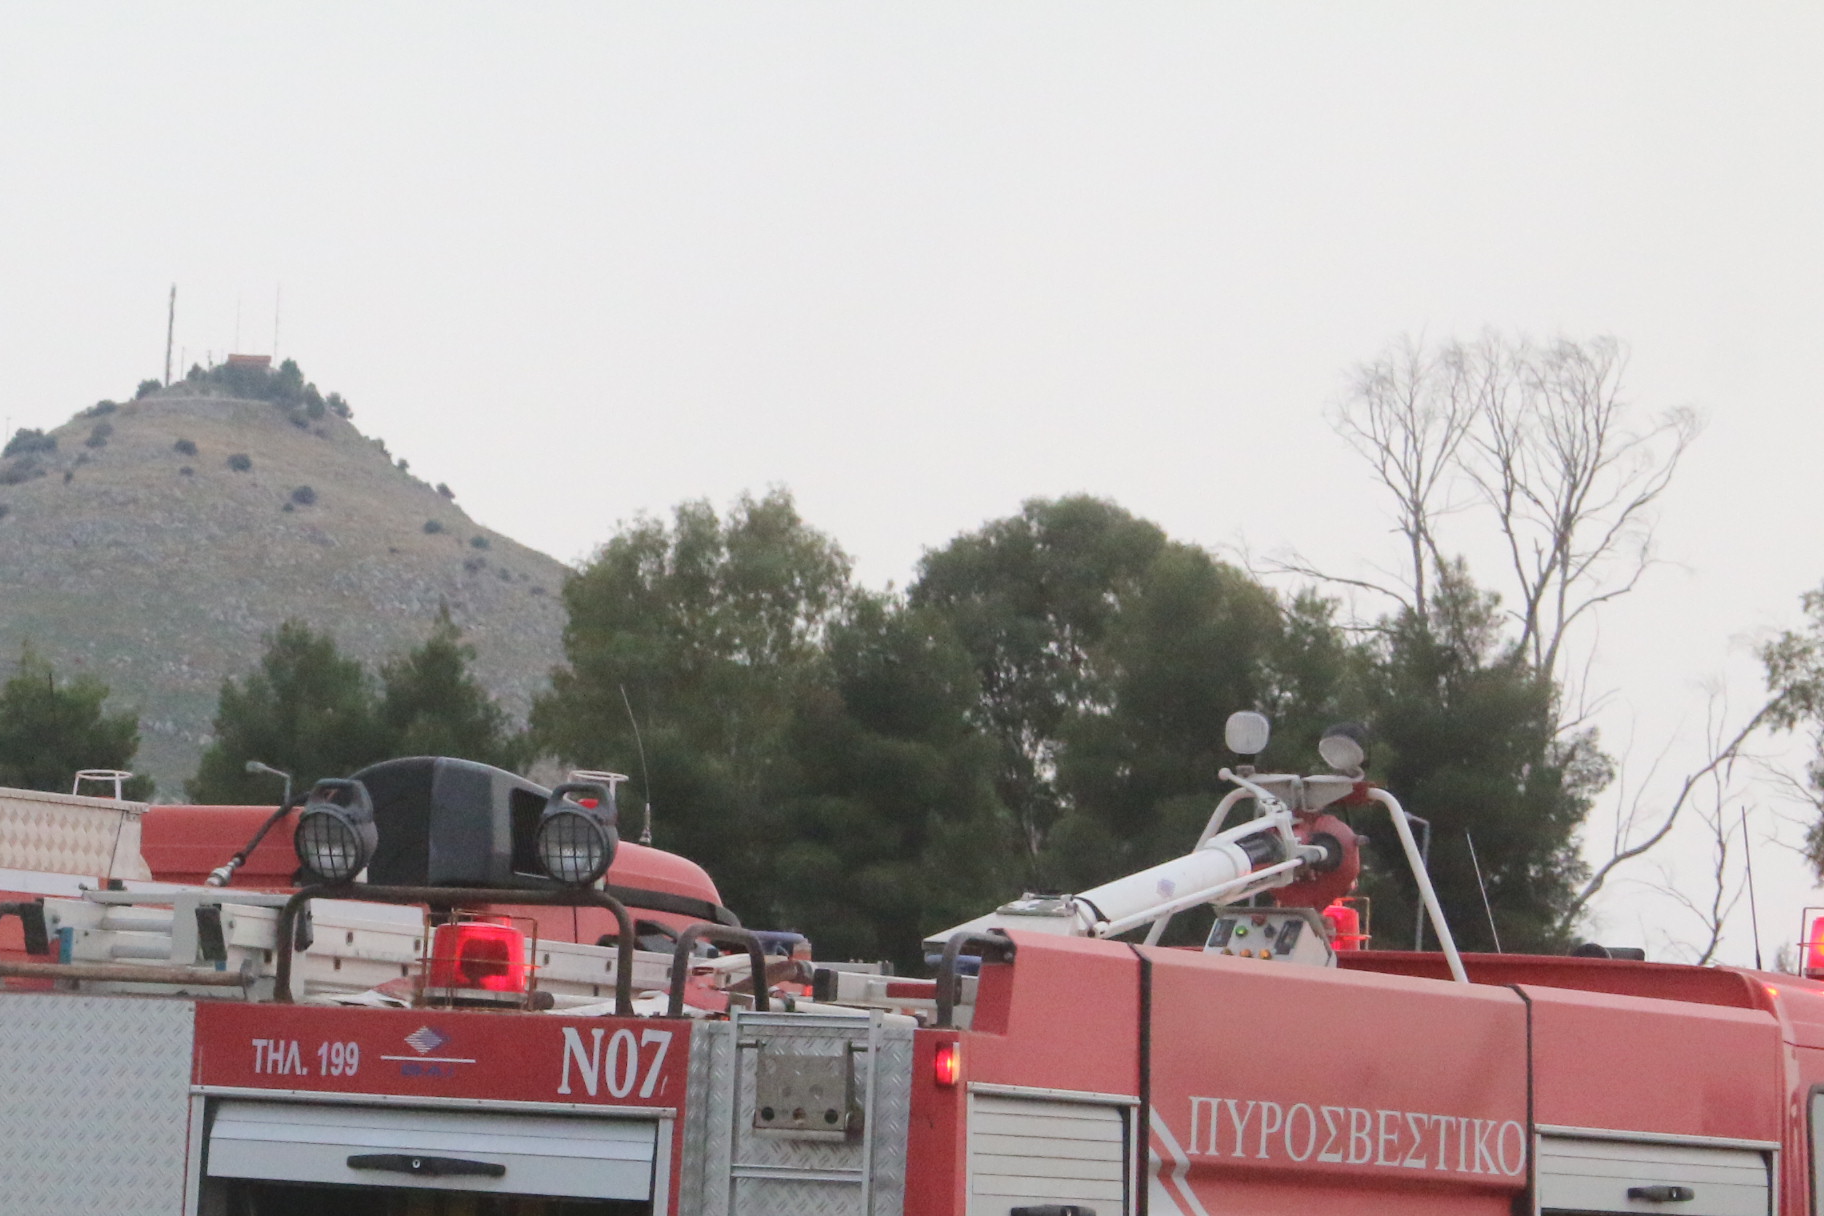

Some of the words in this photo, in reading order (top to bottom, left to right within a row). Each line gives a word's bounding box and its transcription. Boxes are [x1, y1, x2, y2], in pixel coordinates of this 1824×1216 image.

[252, 1038, 308, 1076] ΤΗΛ.
[317, 1041, 360, 1077] 199
[557, 1027, 673, 1098] N07
[1186, 1095, 1527, 1177] ΠΥΡΟΣΒΕΣΤΙΚΟ
